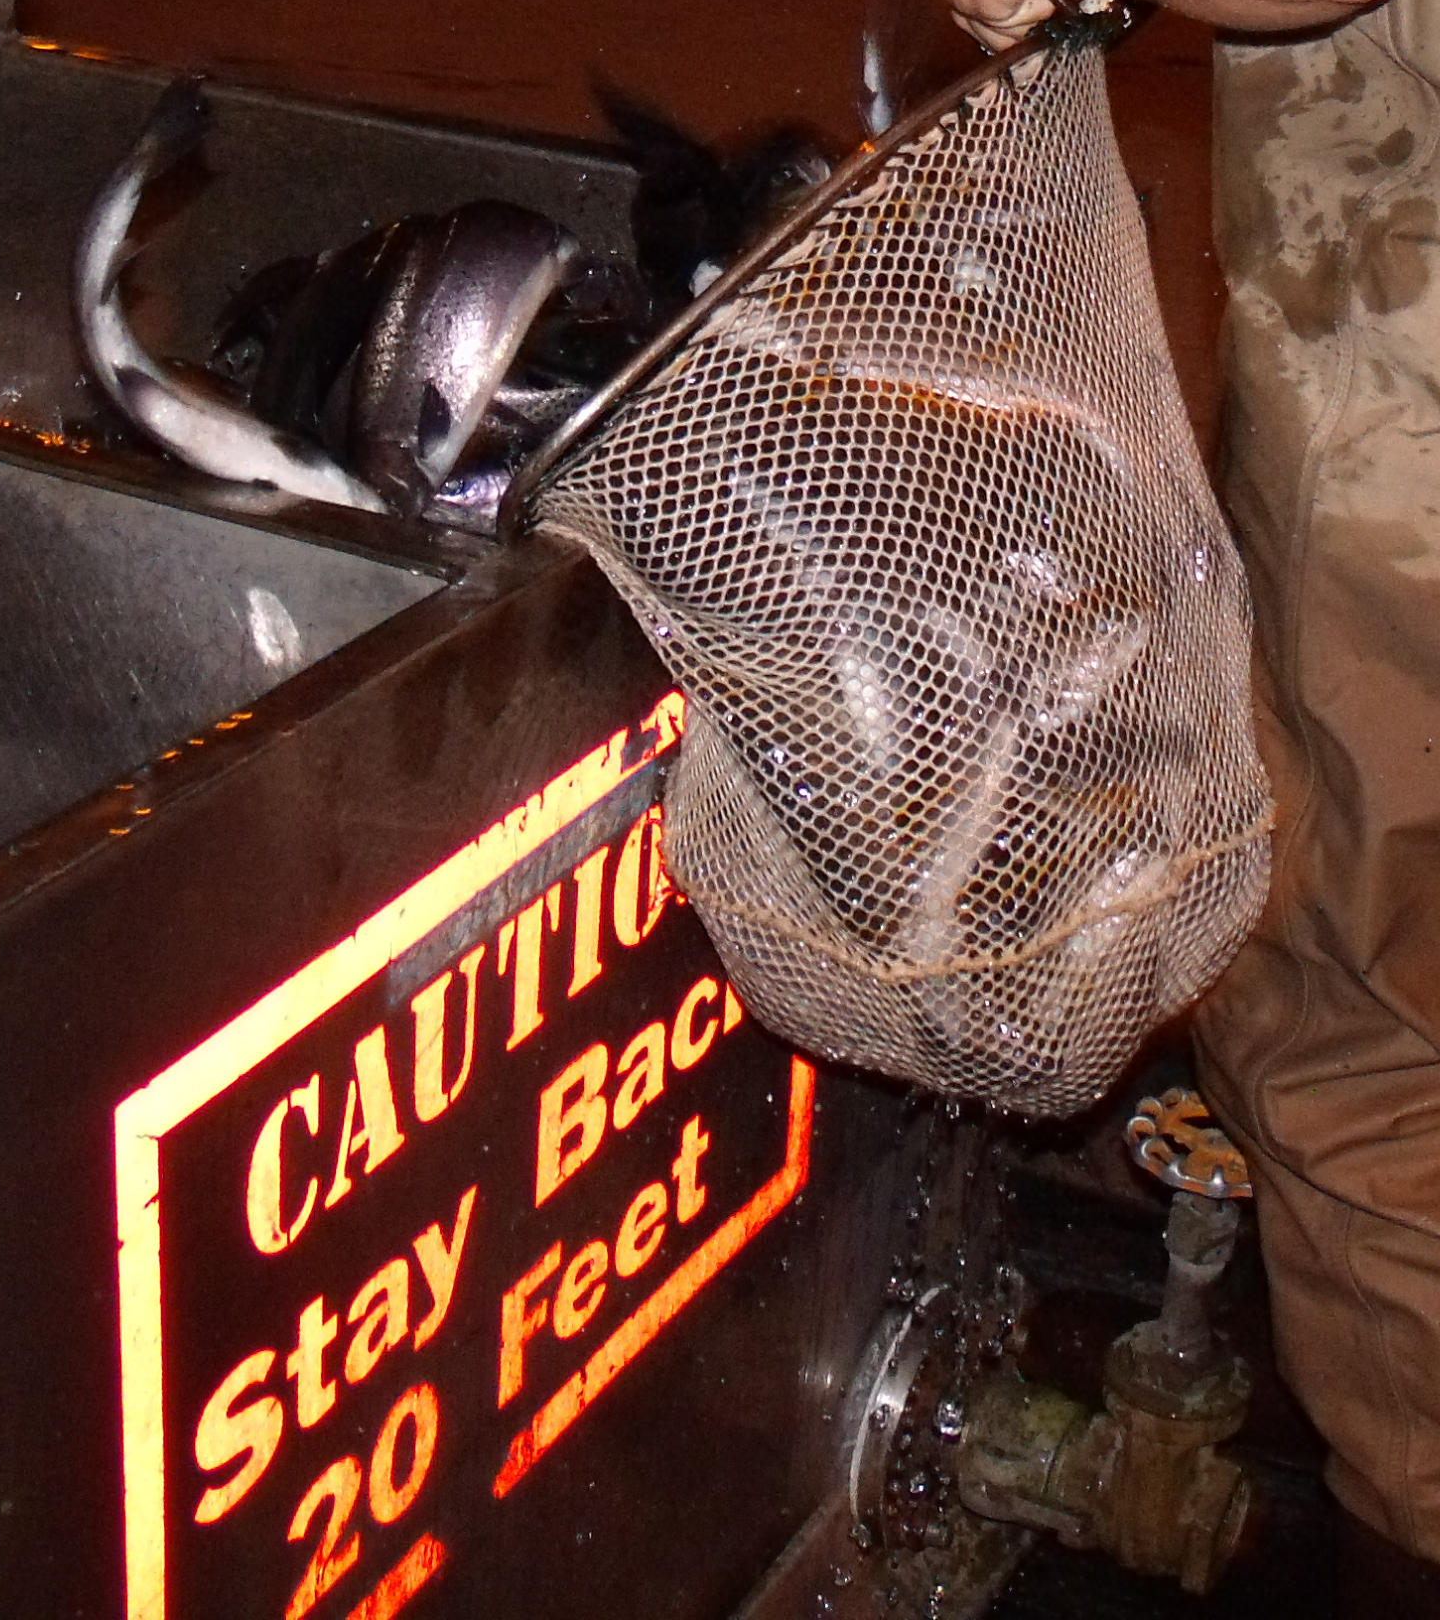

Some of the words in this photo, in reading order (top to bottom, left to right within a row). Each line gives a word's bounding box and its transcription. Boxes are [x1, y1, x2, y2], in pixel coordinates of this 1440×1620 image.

[194, 1186, 477, 1524] Stay
[535, 977, 743, 1208] Bac
[246, 804, 688, 1254] CAUTIO
[285, 1382, 439, 1620] 20
[498, 1115, 710, 1409] Feet
